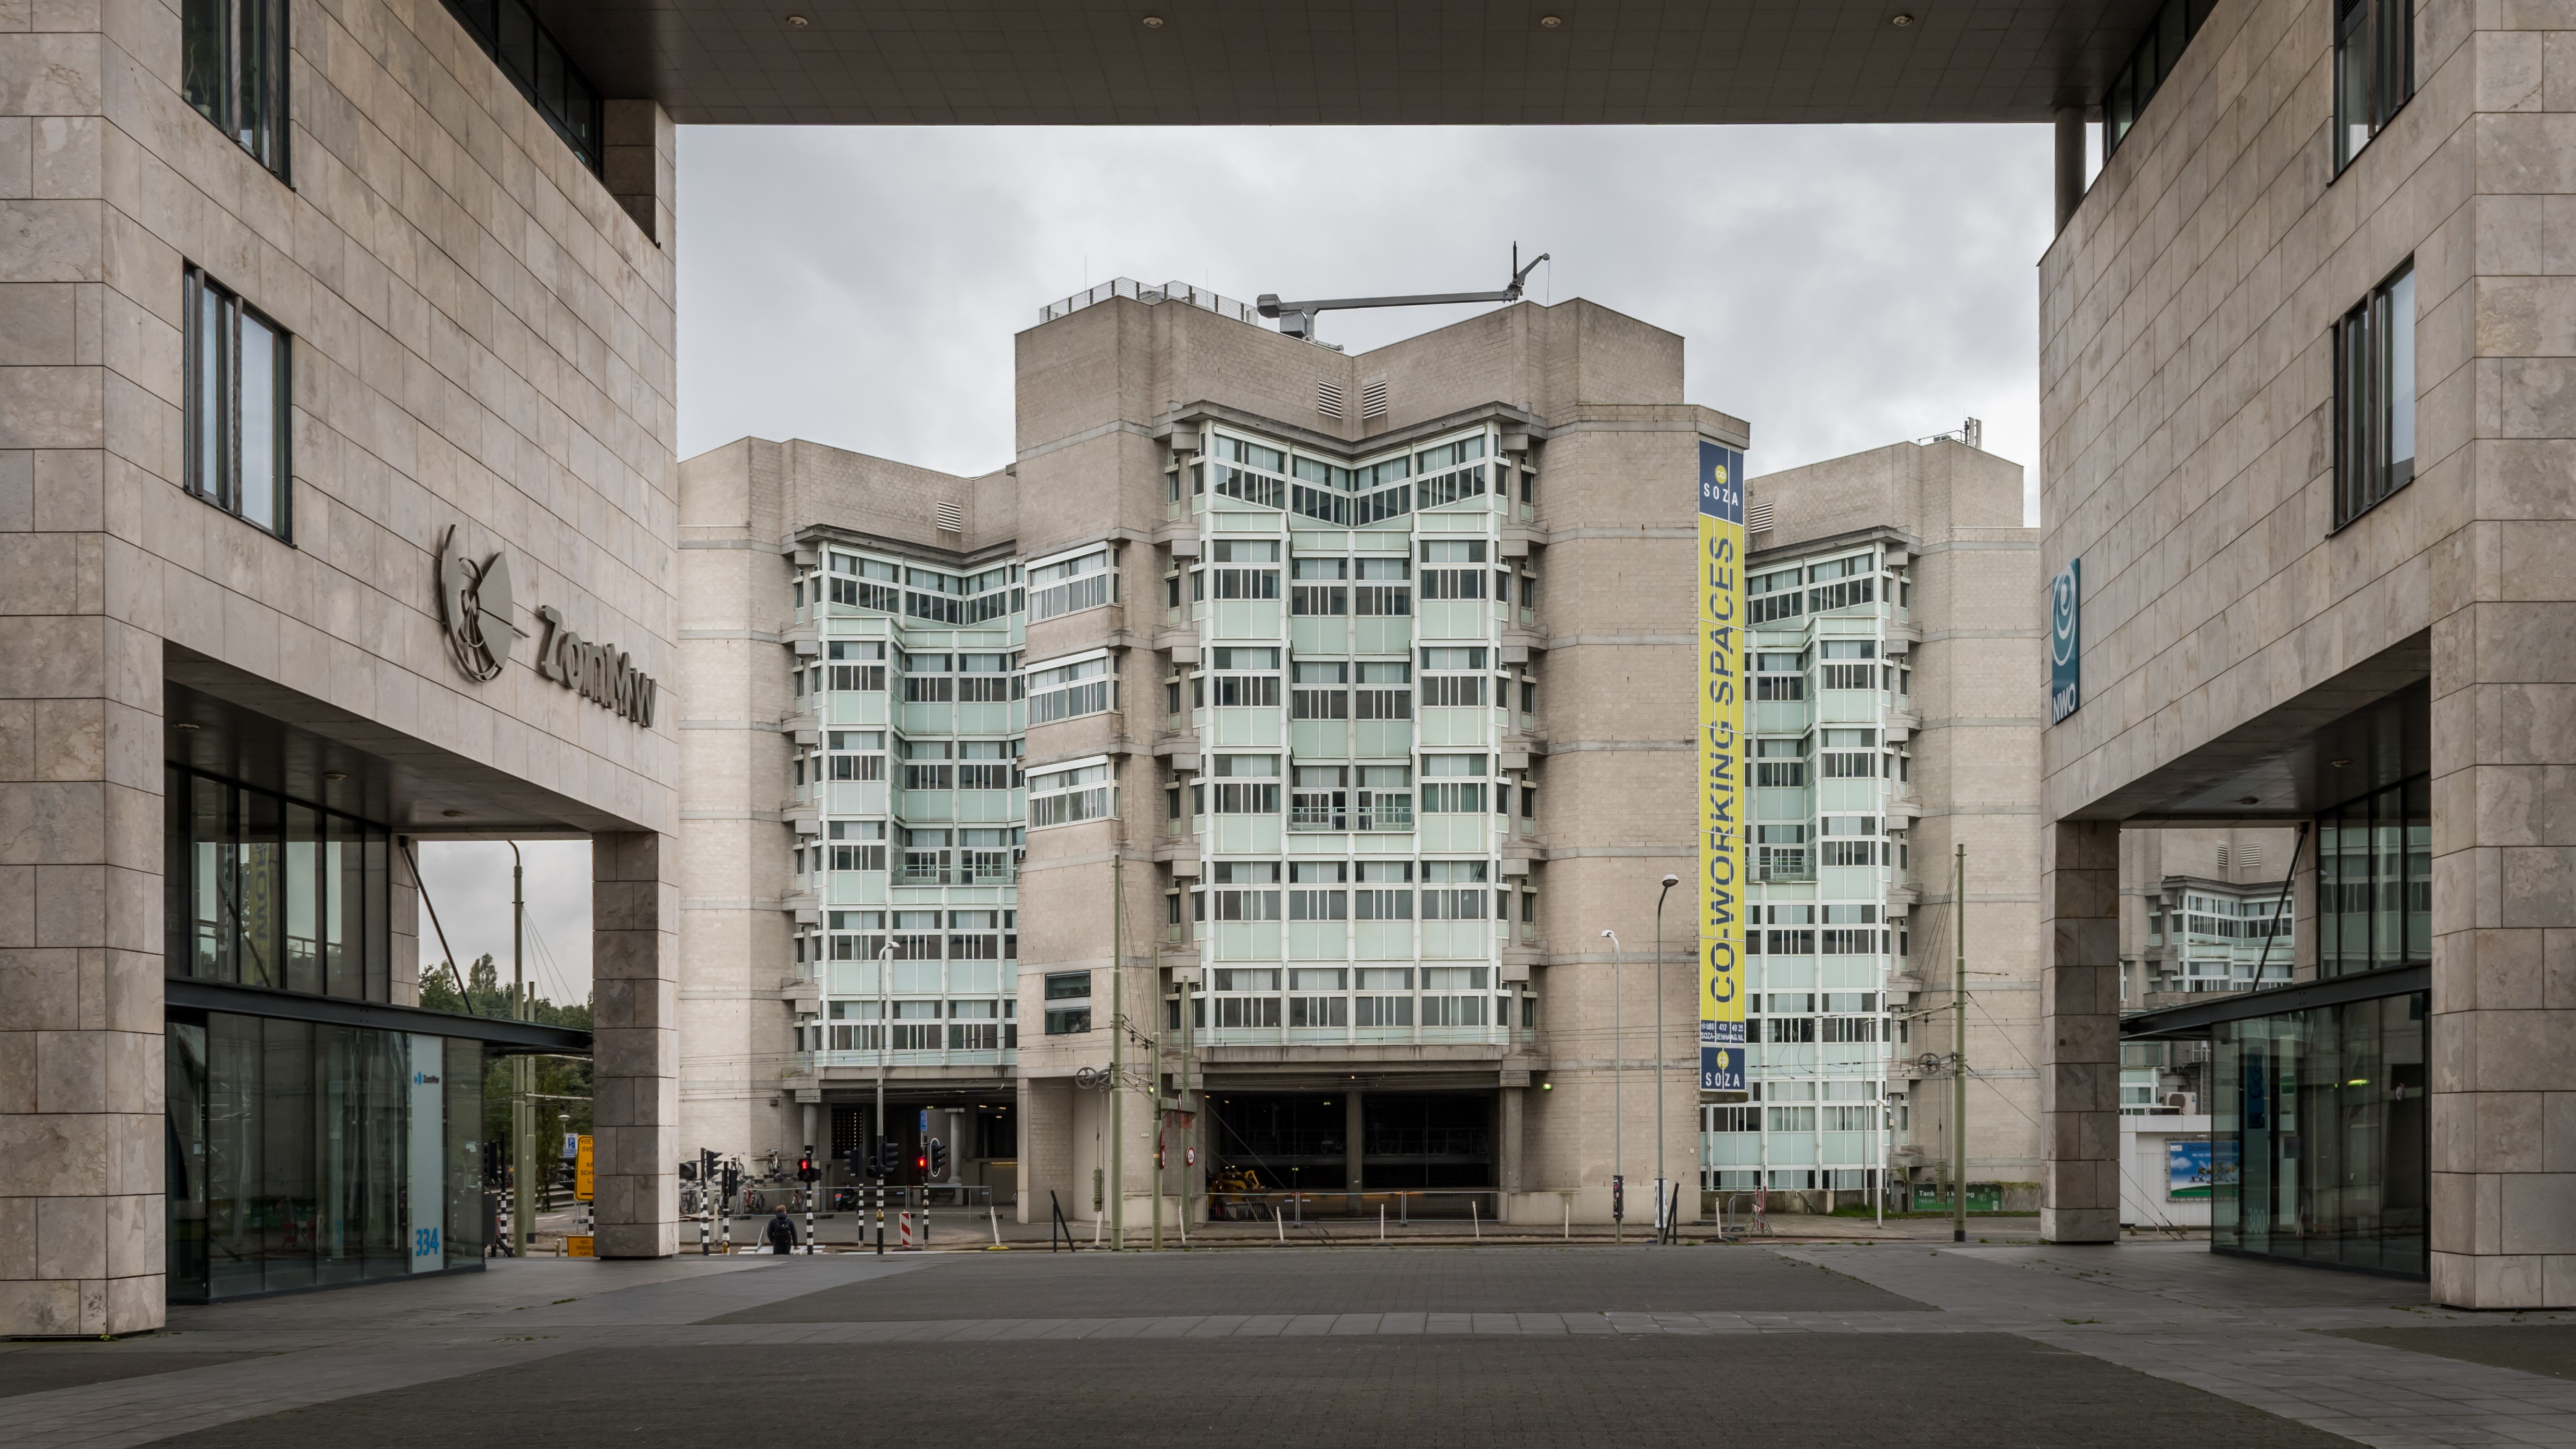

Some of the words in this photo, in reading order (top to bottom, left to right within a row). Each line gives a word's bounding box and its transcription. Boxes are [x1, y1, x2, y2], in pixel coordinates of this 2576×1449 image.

[1704, 483, 1739, 506] SOZA
[1709, 536, 1734, 706] SPACES
[2053, 683, 2076, 724] NWO
[1709, 720, 1735, 1003] CO-WORKING
[1701, 1032, 1744, 1041] SOZA-DENHAAG.NL
[1706, 1072, 1740, 1087] SOZA
[2247, 1207, 2265, 1234] 300
[416, 1227, 440, 1257] 334
